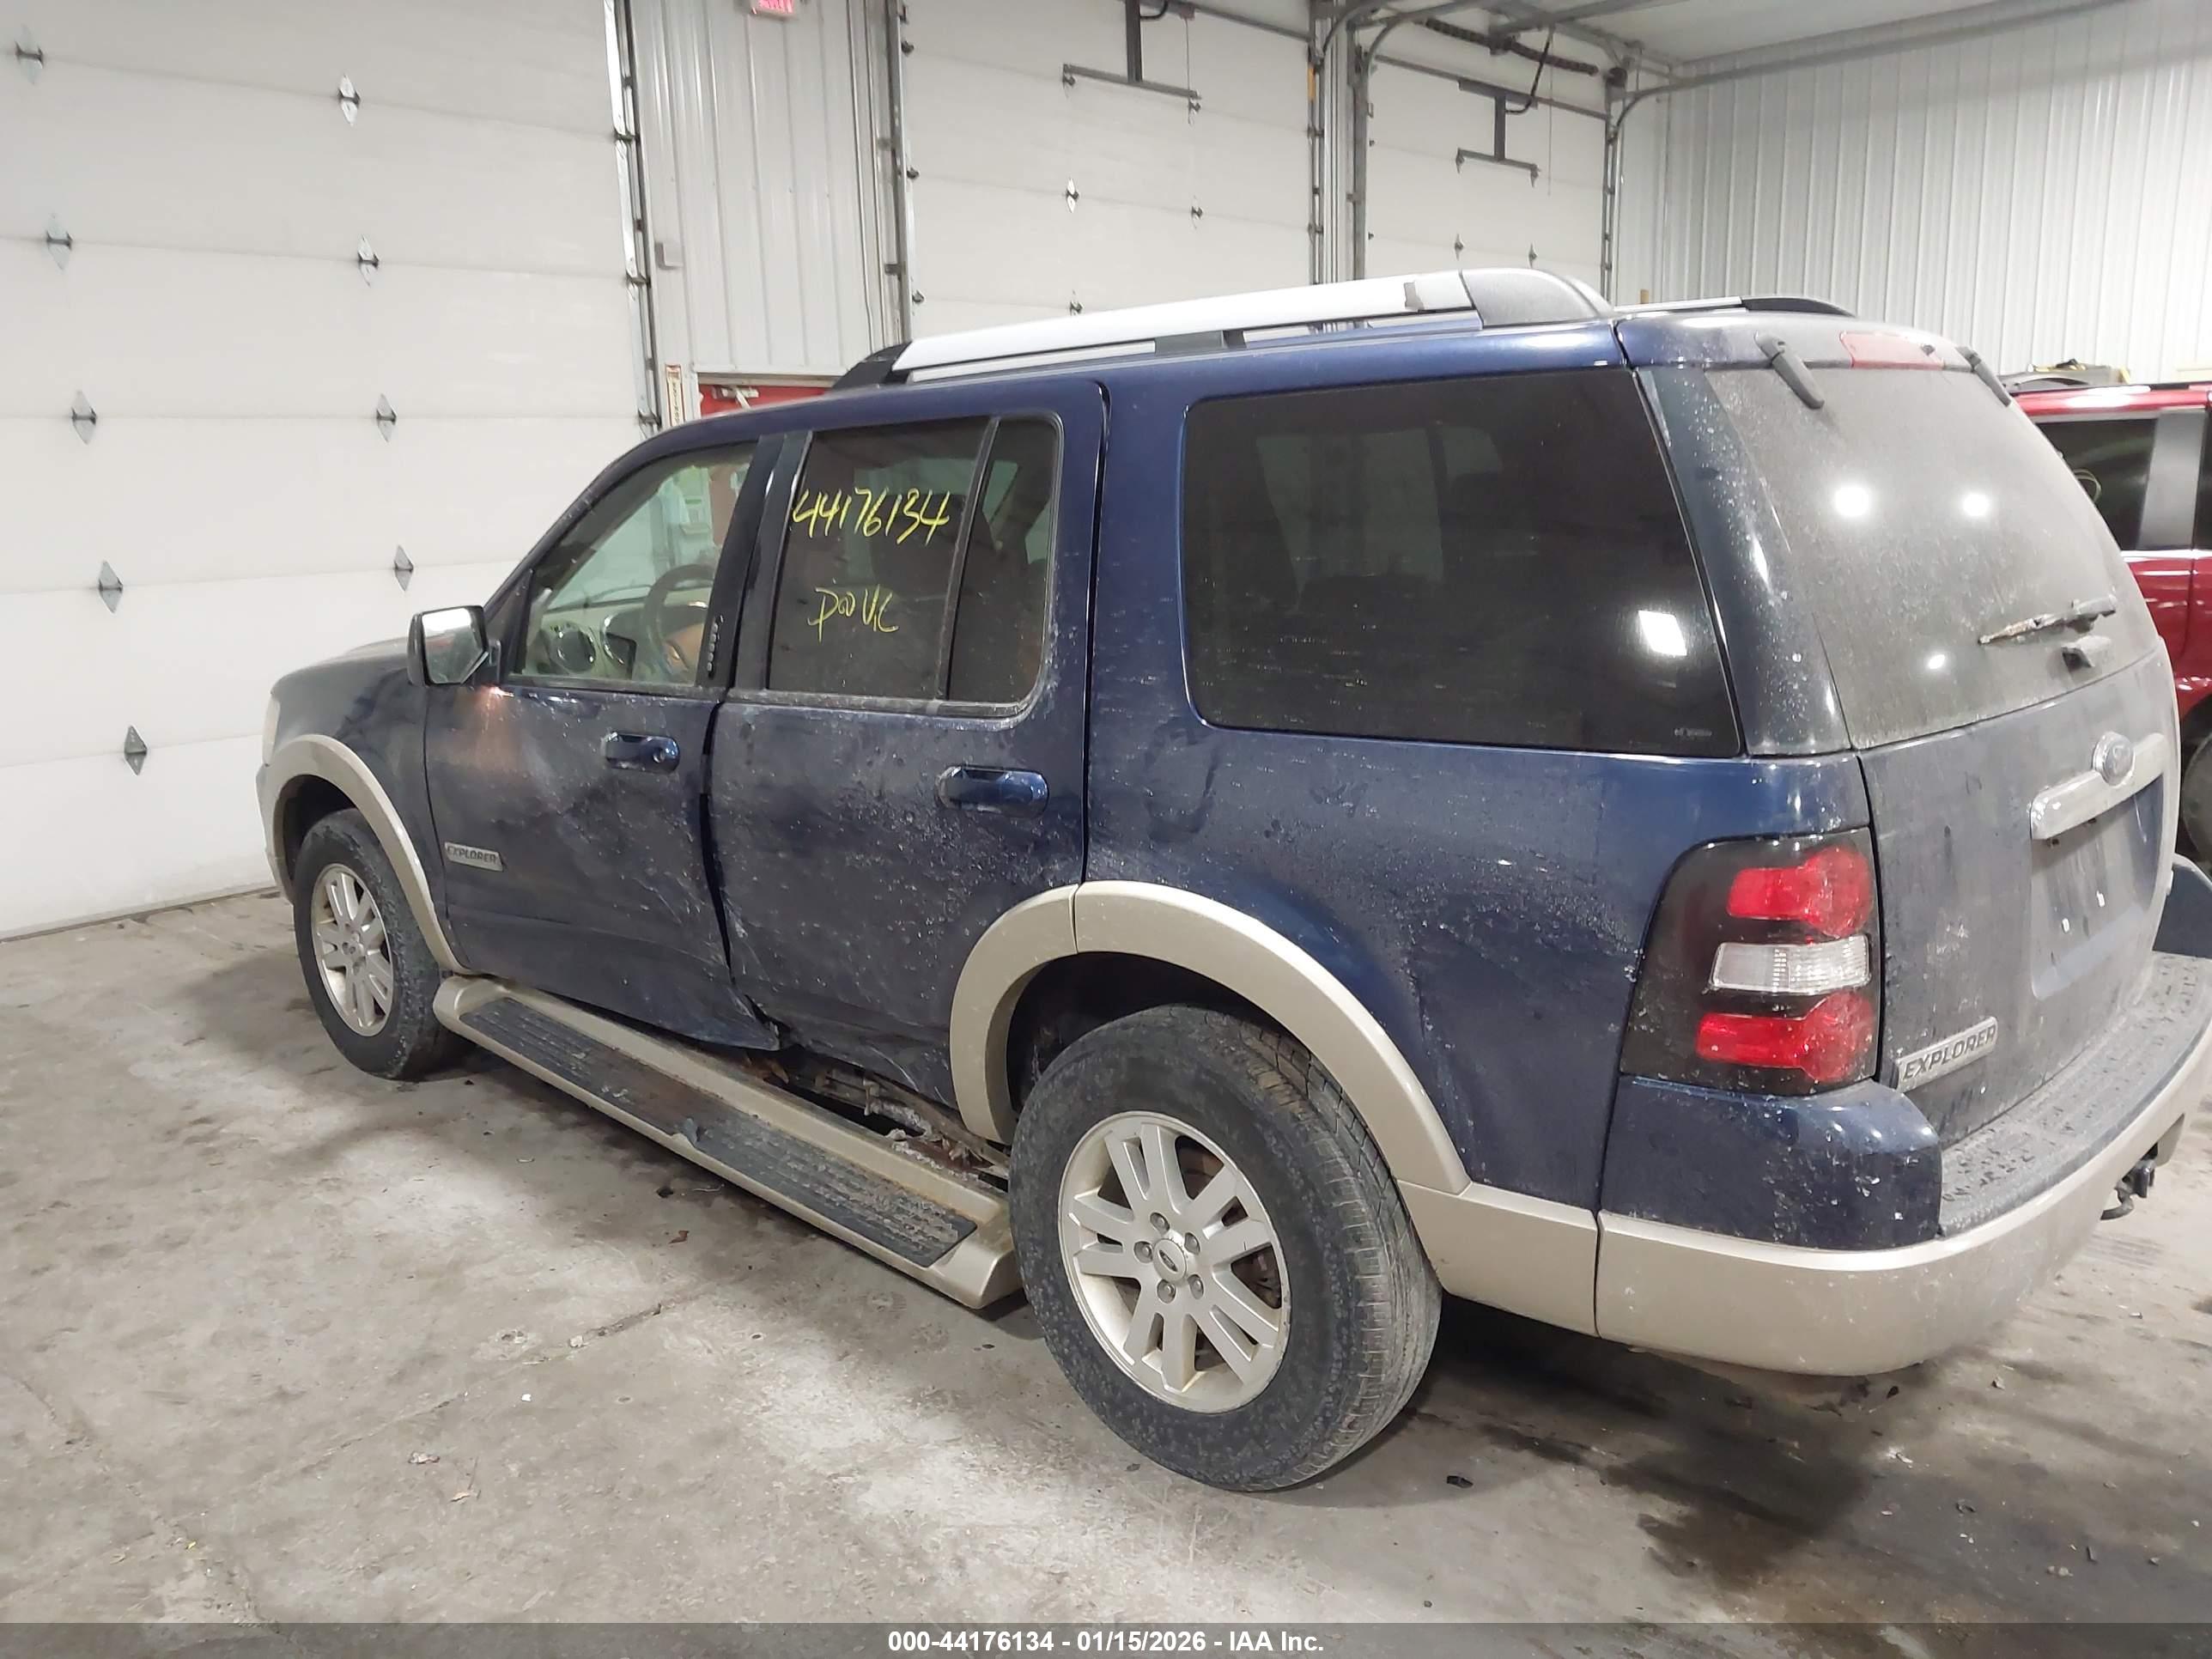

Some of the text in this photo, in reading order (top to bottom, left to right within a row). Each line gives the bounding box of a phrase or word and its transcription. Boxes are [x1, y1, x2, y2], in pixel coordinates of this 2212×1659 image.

[793, 487, 951, 545] 44176134
[446, 845, 498, 865] EXPLORER
[1902, 1024, 1996, 1080] EXPLORER
